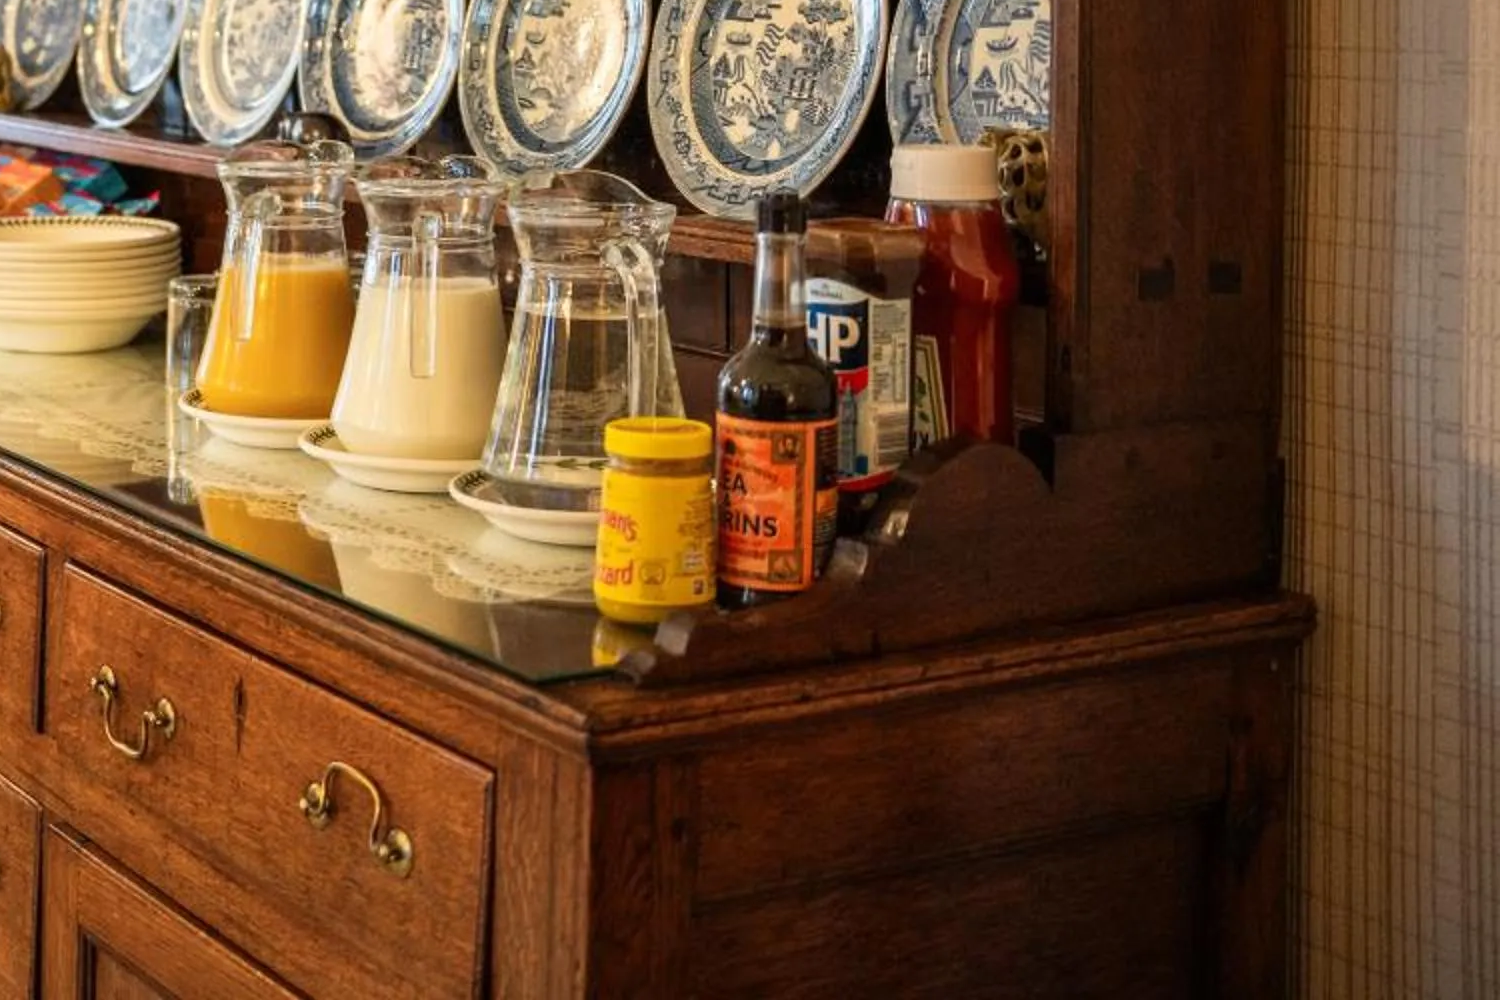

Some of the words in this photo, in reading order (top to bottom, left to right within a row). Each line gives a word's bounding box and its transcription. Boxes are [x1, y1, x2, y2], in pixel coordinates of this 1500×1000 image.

[805, 310, 860, 364] HP
[720, 471, 748, 496] EA
[721, 509, 779, 538] RINS
